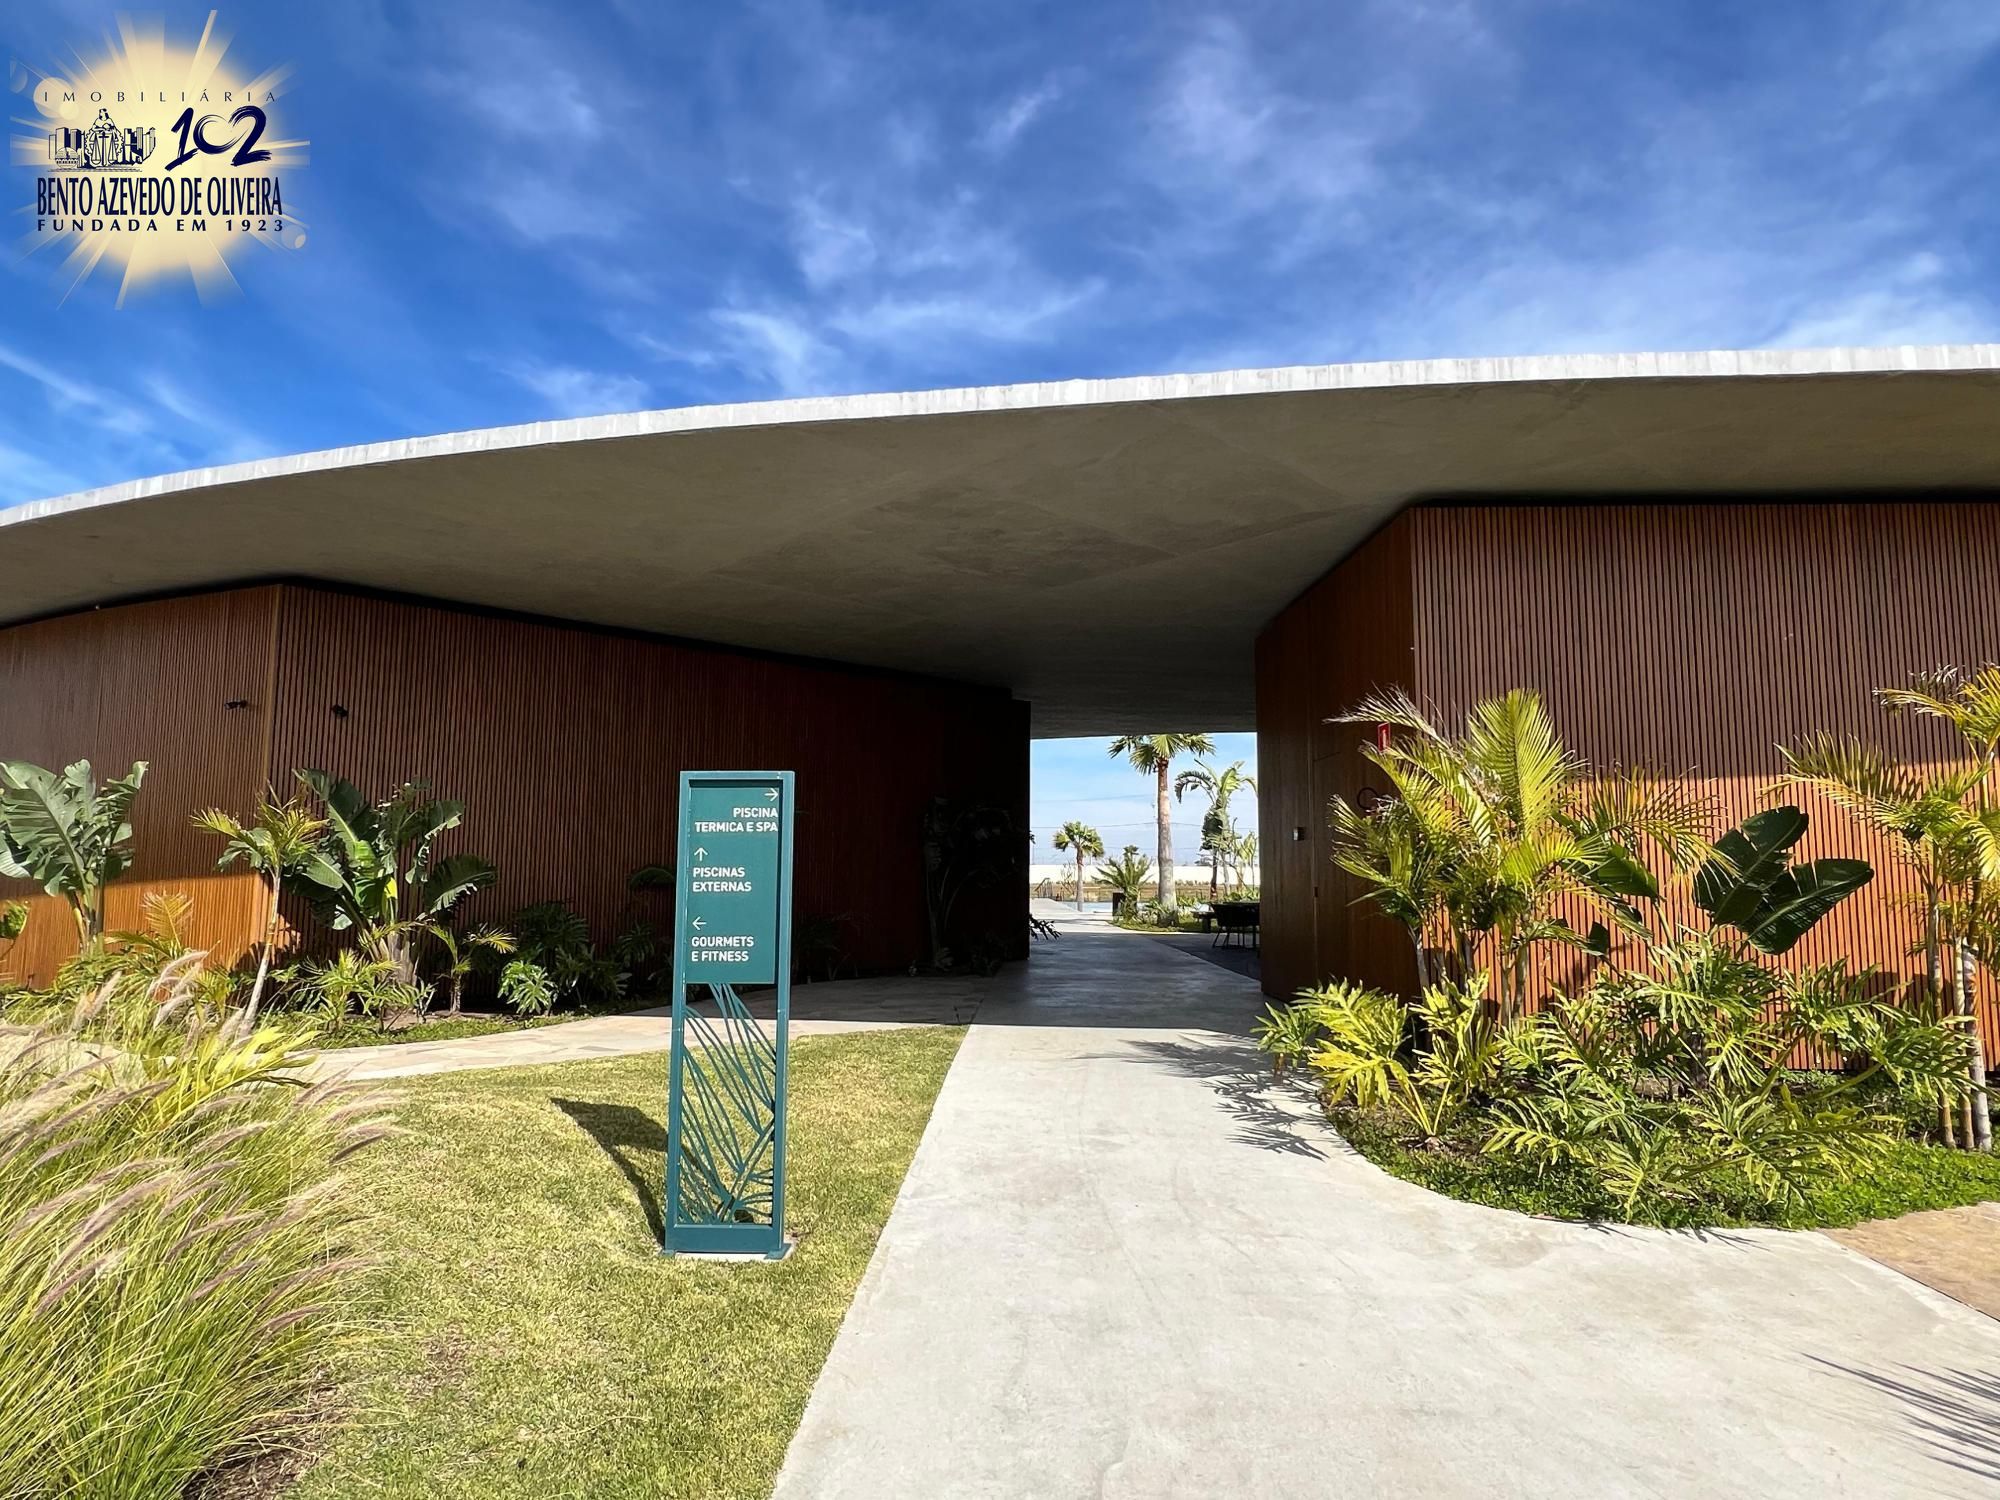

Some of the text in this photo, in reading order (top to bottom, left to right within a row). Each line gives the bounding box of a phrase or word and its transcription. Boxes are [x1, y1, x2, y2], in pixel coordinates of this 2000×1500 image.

[733, 807, 778, 818] PISCINA
[694, 822, 778, 832] TERMICA E SPA
[692, 867, 745, 877] PISCINAS
[692, 882, 752, 892] EXTERNAS
[691, 936, 754, 947] GOURMETS
[691, 951, 749, 962] E FITNESS
